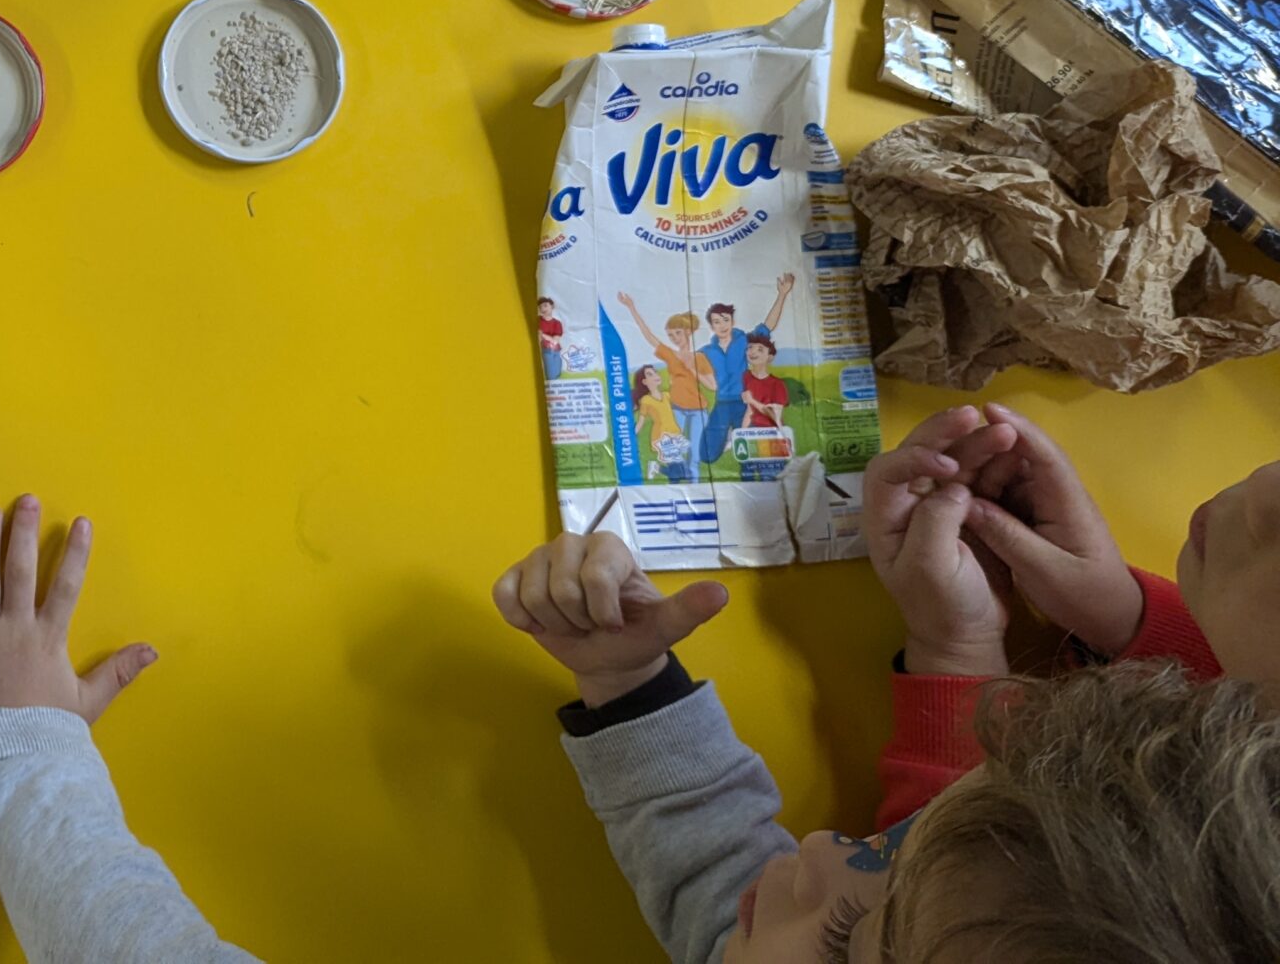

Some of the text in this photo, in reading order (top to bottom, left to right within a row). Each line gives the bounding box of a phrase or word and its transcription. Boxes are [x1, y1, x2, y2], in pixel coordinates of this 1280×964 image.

[659, 76, 739, 99] candia
[607, 123, 781, 215] Viva
[655, 207, 749, 236] 10 VITAMINES
[675, 209, 723, 222] SOURCE DE
[634, 209, 769, 253] CALCIUM & VITAMINE D
[610, 354, 634, 467] Vitalité & Plaisir
[736, 443, 747, 455] A
